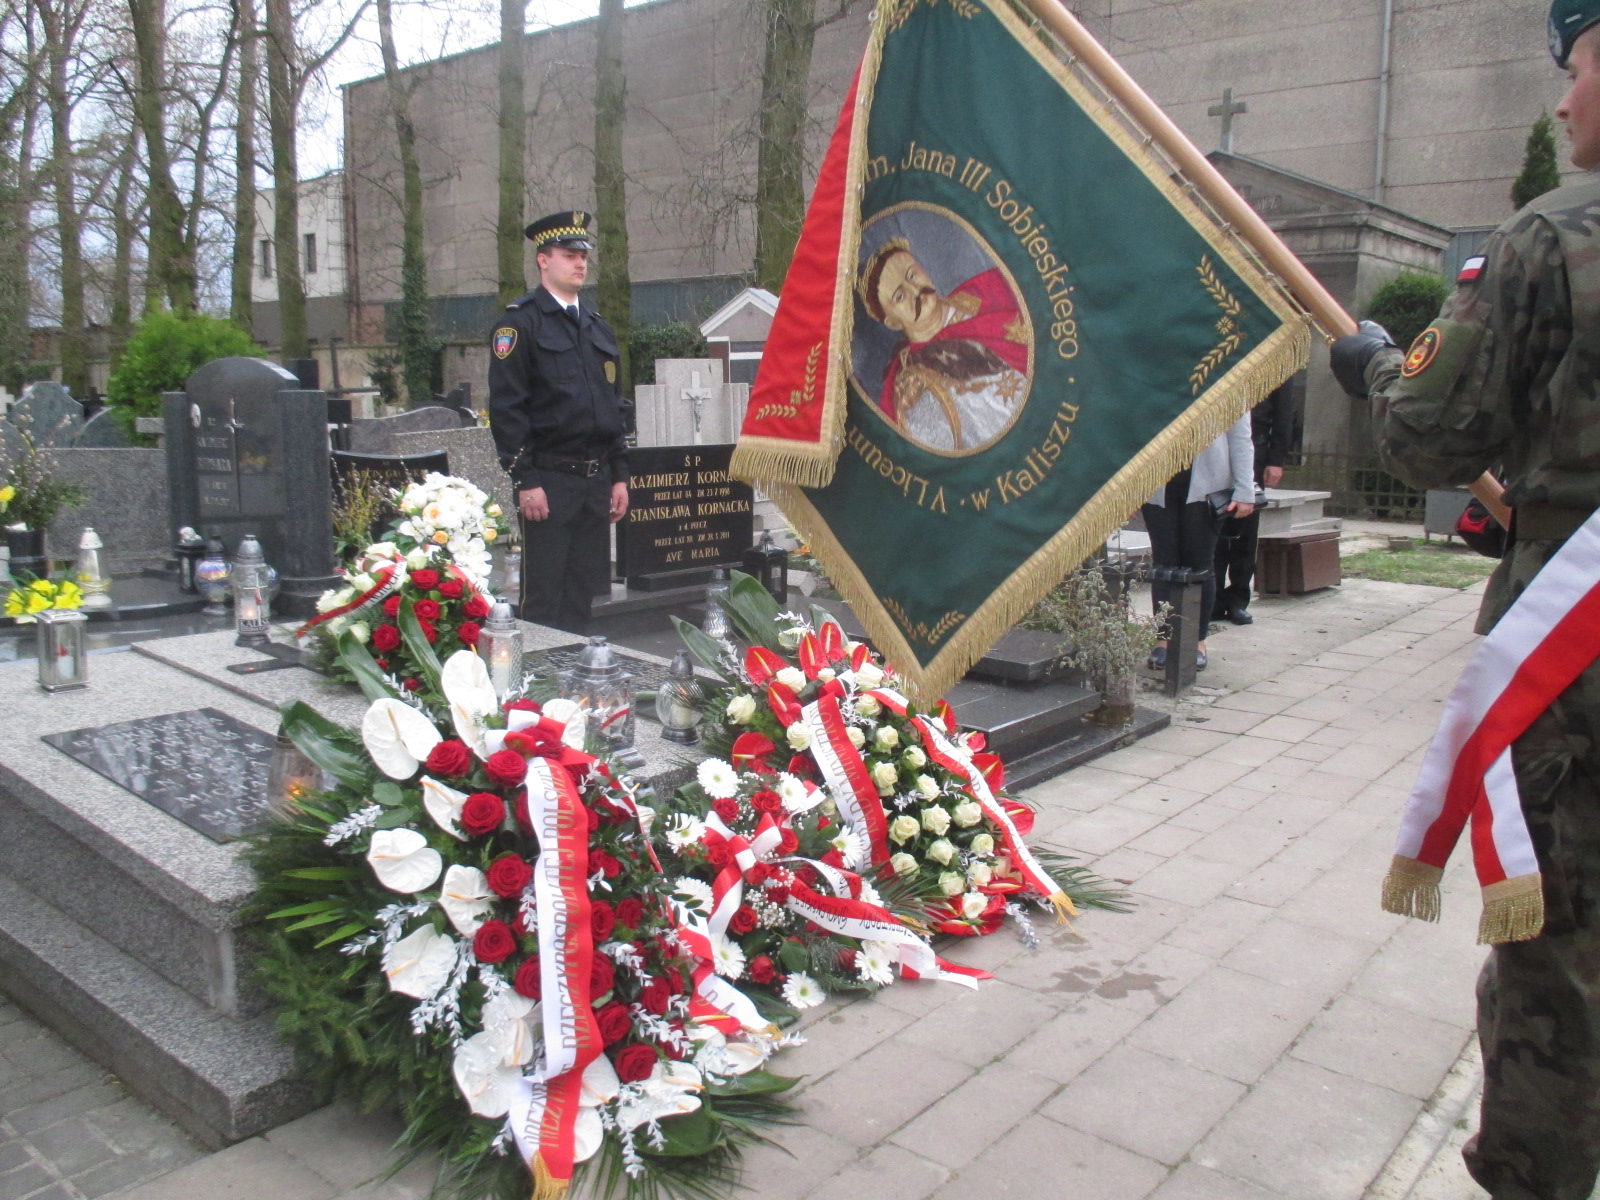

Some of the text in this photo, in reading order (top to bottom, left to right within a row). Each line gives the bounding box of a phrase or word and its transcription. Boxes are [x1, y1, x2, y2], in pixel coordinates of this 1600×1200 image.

[901, 141, 957, 179] Jana
[958, 156, 992, 192] III
[985, 179, 1079, 360] Sobieskiego
[630, 470, 742, 490] KAZIMIERZ KORNA
[848, 425, 930, 507] Liceum
[998, 401, 1080, 505] Kaliszu
[630, 499, 750, 523] STANISŁAWA KORNACKA
[665, 547, 720, 563] AVE MARIA
[533, 764, 577, 841] POLSKIEJ
[542, 846, 592, 1051] RZECZYPOSPOLITEJ
